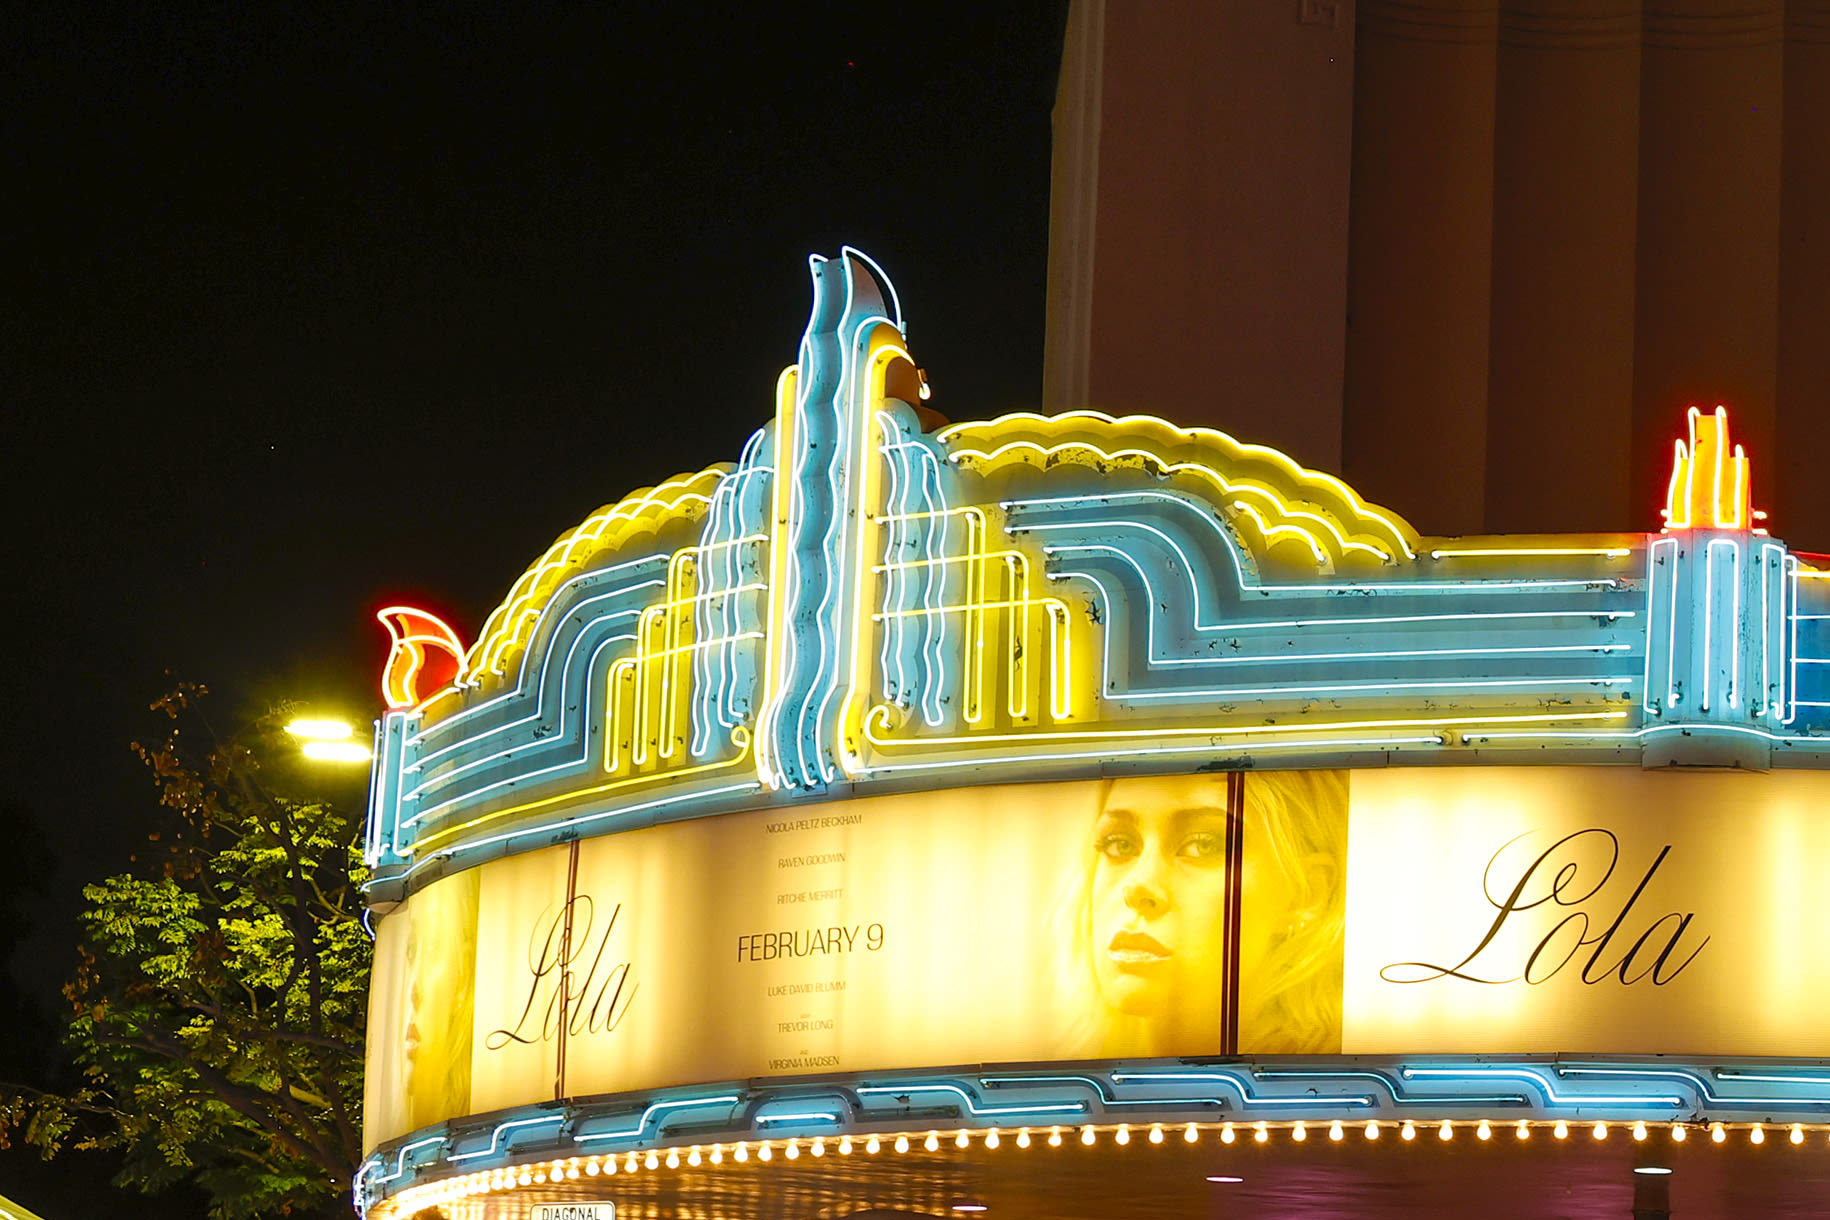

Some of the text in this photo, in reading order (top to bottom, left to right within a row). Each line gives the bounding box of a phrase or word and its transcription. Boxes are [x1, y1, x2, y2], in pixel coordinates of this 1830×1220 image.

[796, 818, 820, 831] PELTZ
[821, 814, 863, 828] BECKHAM
[737, 923, 884, 963] FEBRUARY 9
[1379, 827, 1711, 986] Lola
[485, 894, 641, 1051] Lola
